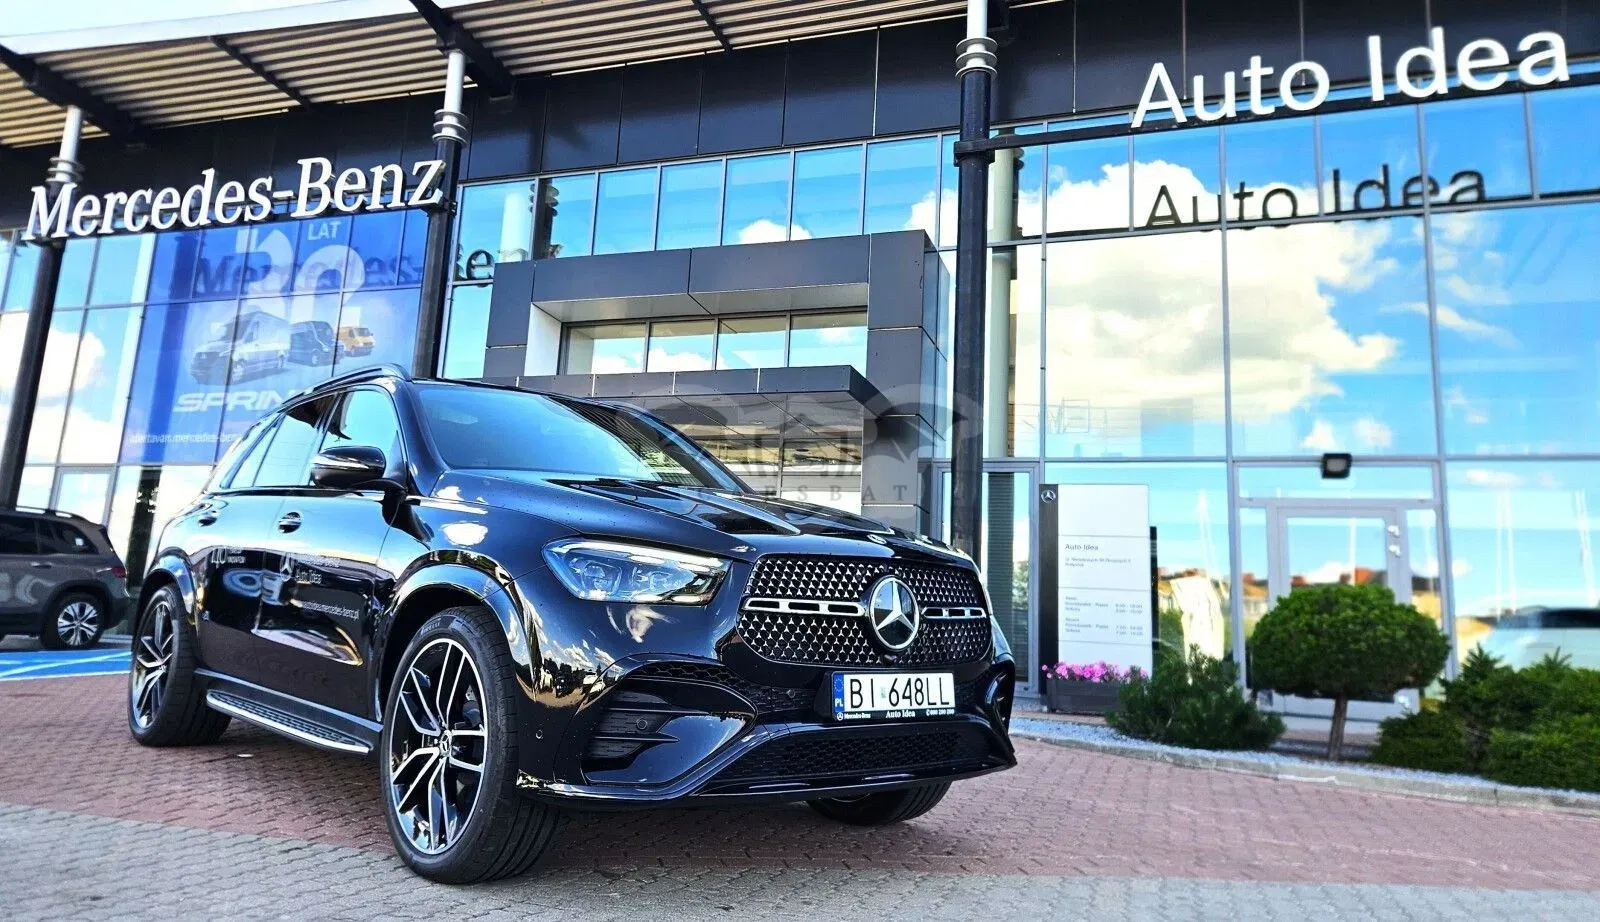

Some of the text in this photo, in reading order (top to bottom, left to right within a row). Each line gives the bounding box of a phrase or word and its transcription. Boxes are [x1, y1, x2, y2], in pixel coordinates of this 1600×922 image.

[1131, 26, 1570, 128] Auto Idea
[22, 156, 445, 242] Mercedes-Benz
[307, 220, 342, 241] LAT
[1065, 543, 1099, 551] Auto Idea
[834, 698, 844, 708] PL
[850, 677, 950, 709] BI 648LL
[885, 709, 916, 719] Auto Idea
